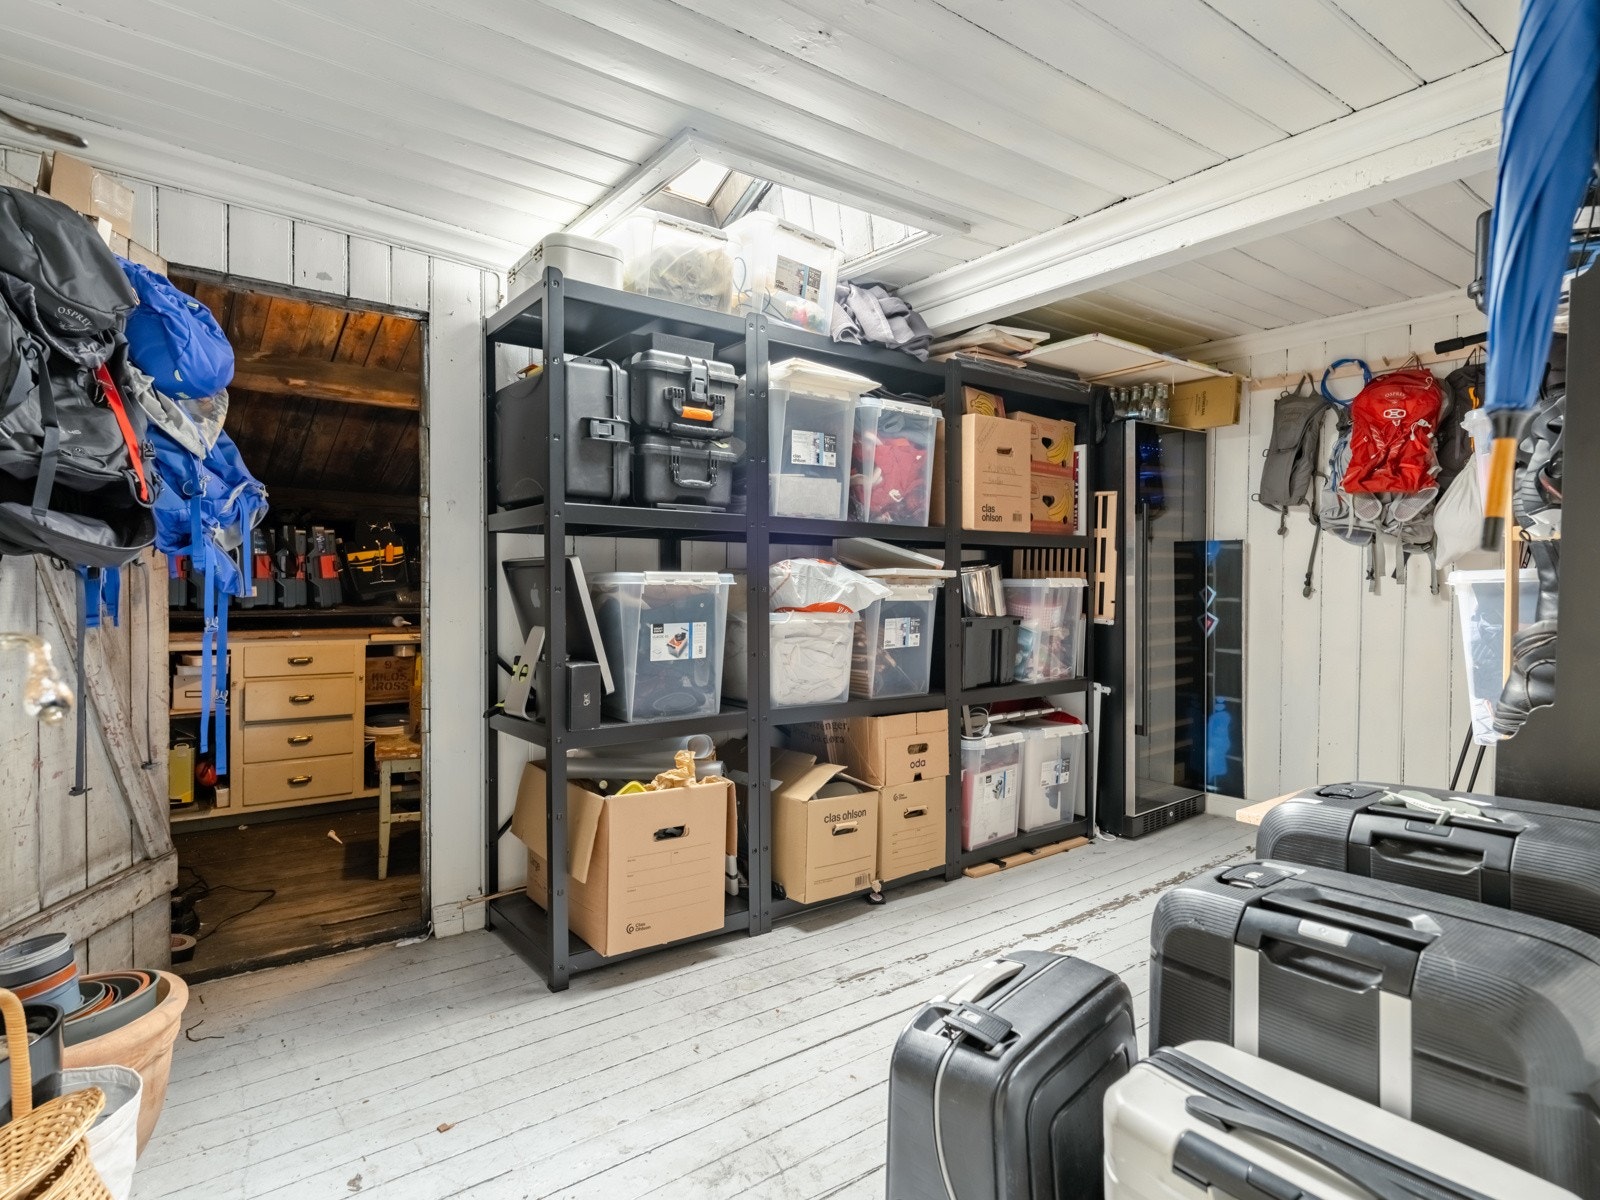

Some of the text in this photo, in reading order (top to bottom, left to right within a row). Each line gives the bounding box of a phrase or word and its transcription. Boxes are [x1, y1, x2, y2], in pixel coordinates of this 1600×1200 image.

[57, 306, 93, 327] OSPREY
[981, 504, 996, 513] clas
[981, 513, 1003, 522] ohlson
[910, 759, 926, 769] oda
[823, 809, 867, 824] clas ohlson
